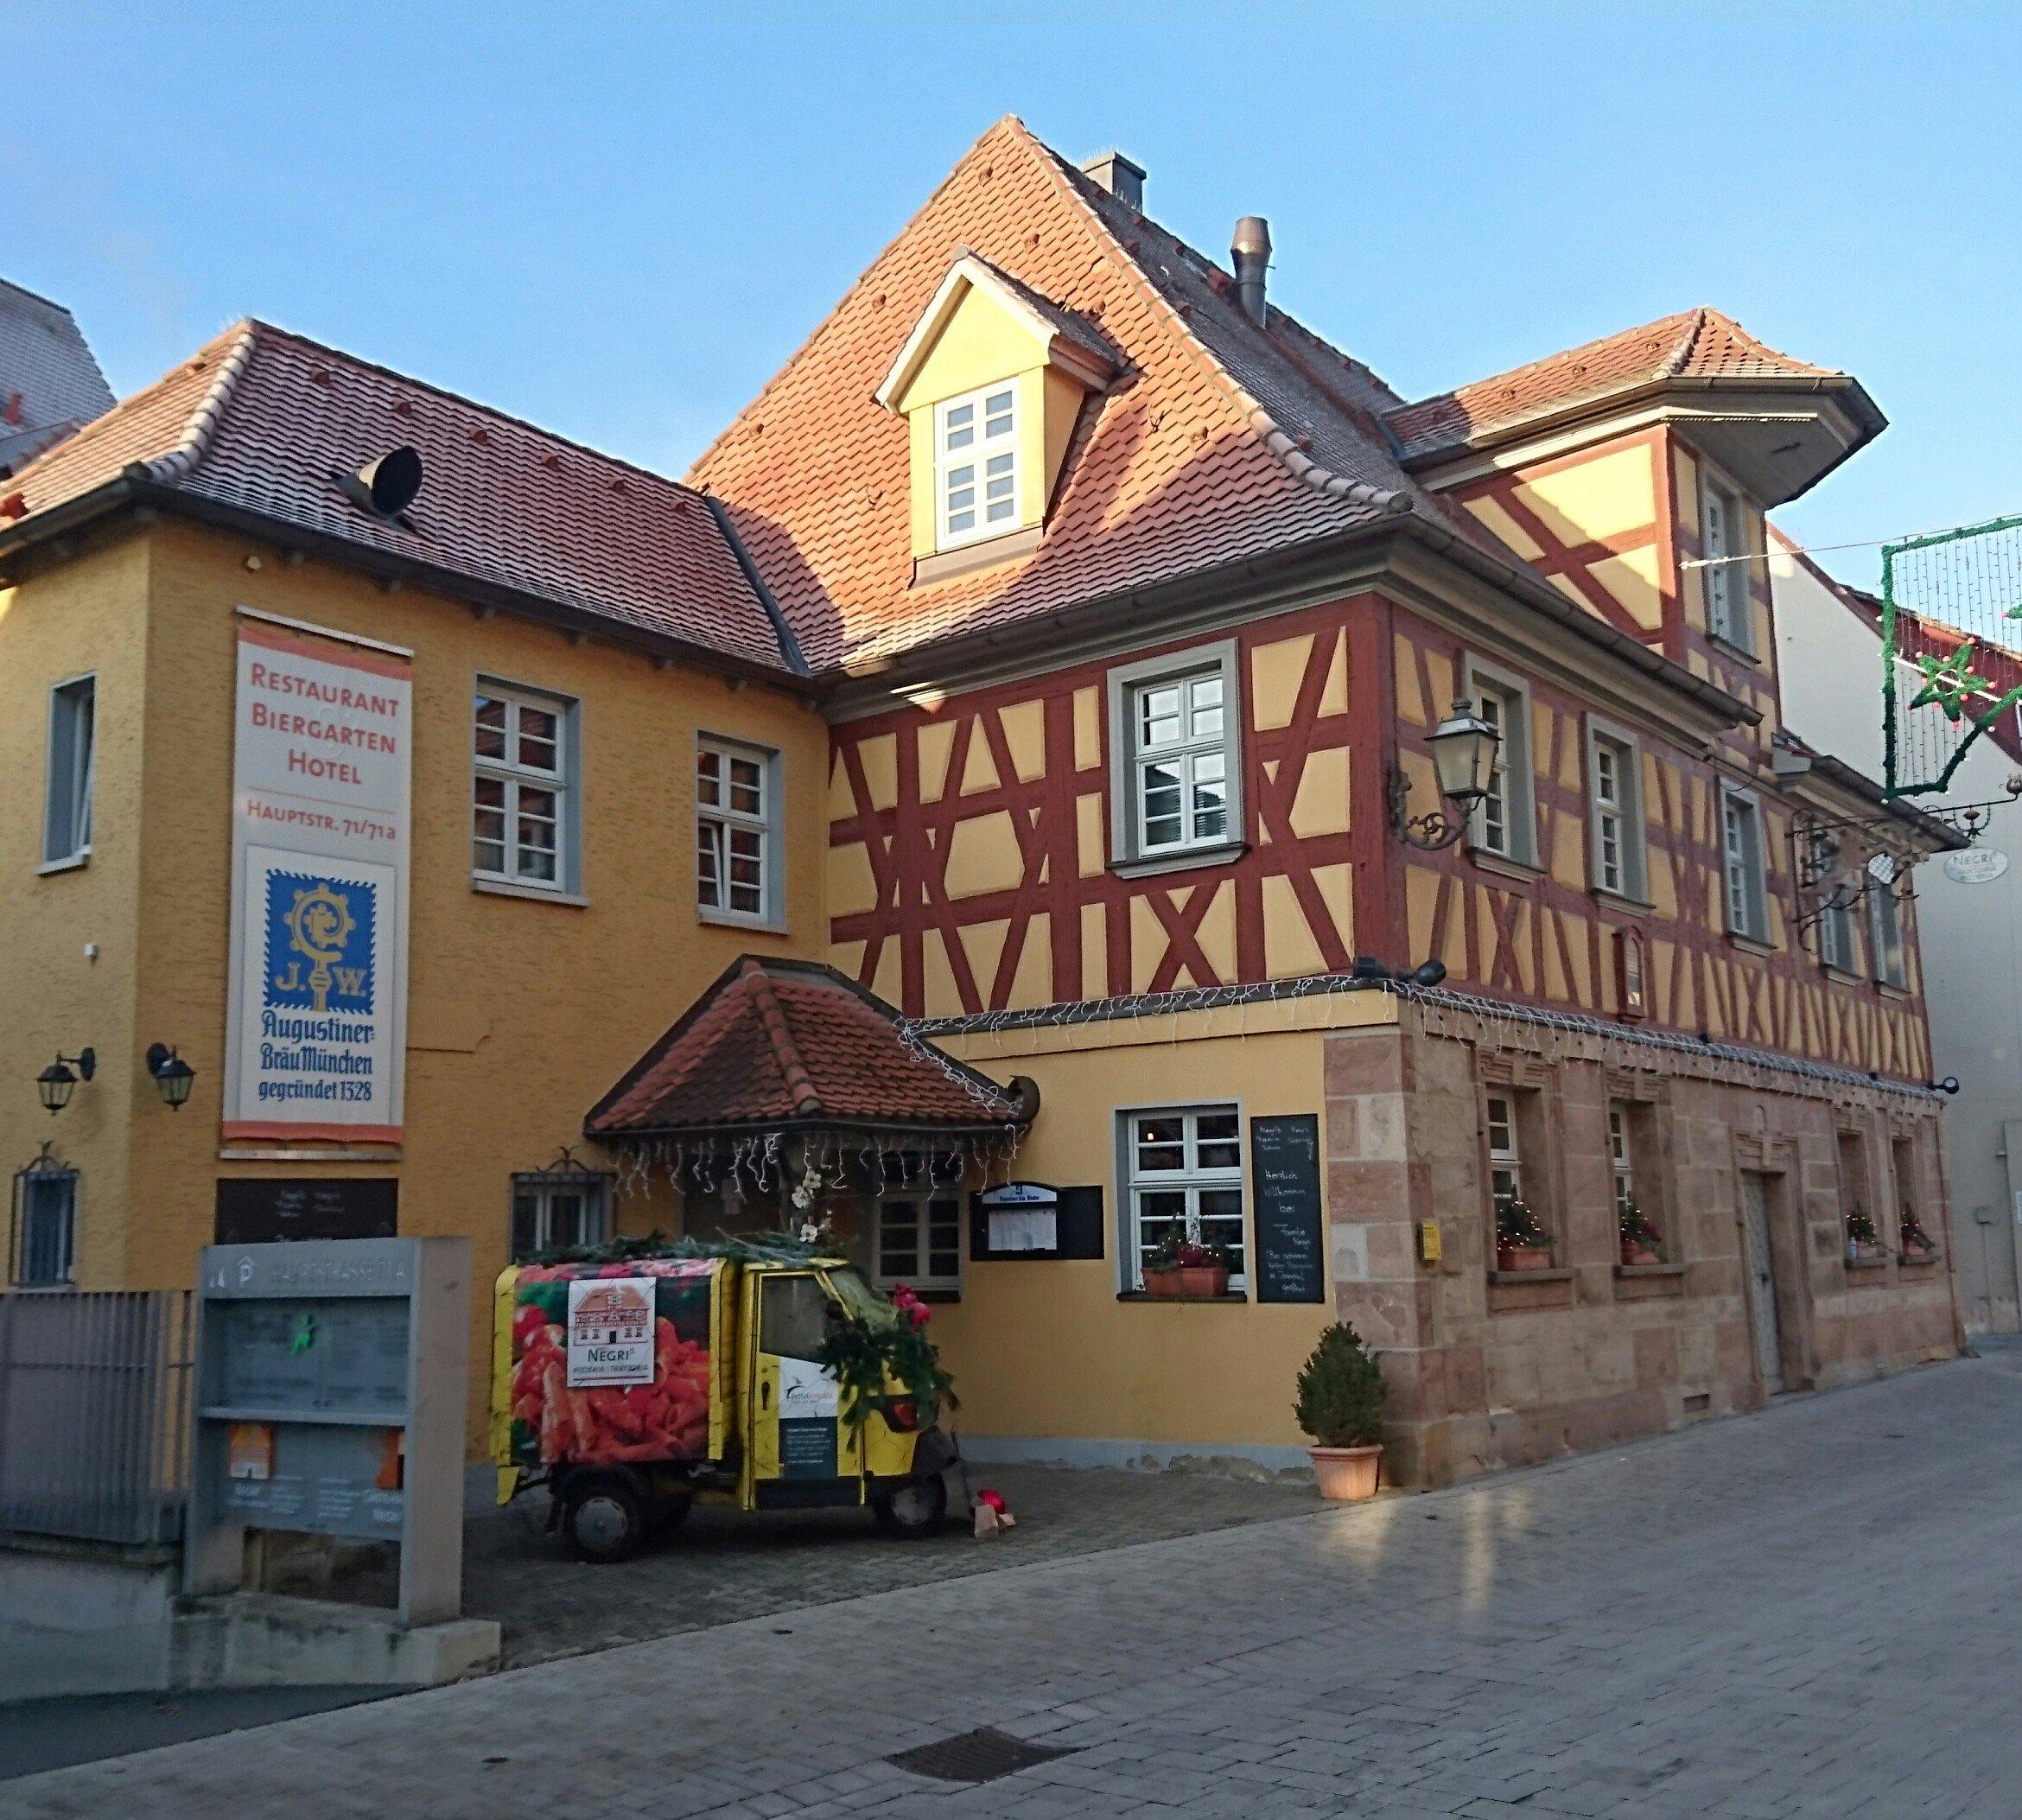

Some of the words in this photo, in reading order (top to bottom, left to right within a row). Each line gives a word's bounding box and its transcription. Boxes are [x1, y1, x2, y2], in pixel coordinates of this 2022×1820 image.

[250, 662, 399, 716] RESTAURANT
[251, 702, 396, 754] BIERGARTEN
[288, 748, 361, 785] HOTEL
[247, 799, 339, 831] HAUPTSTR.
[260, 1042, 301, 1071] Bräu
[301, 1046, 372, 1075] München
[258, 1079, 337, 1102] gegründet
[340, 1081, 372, 1101] 1328
